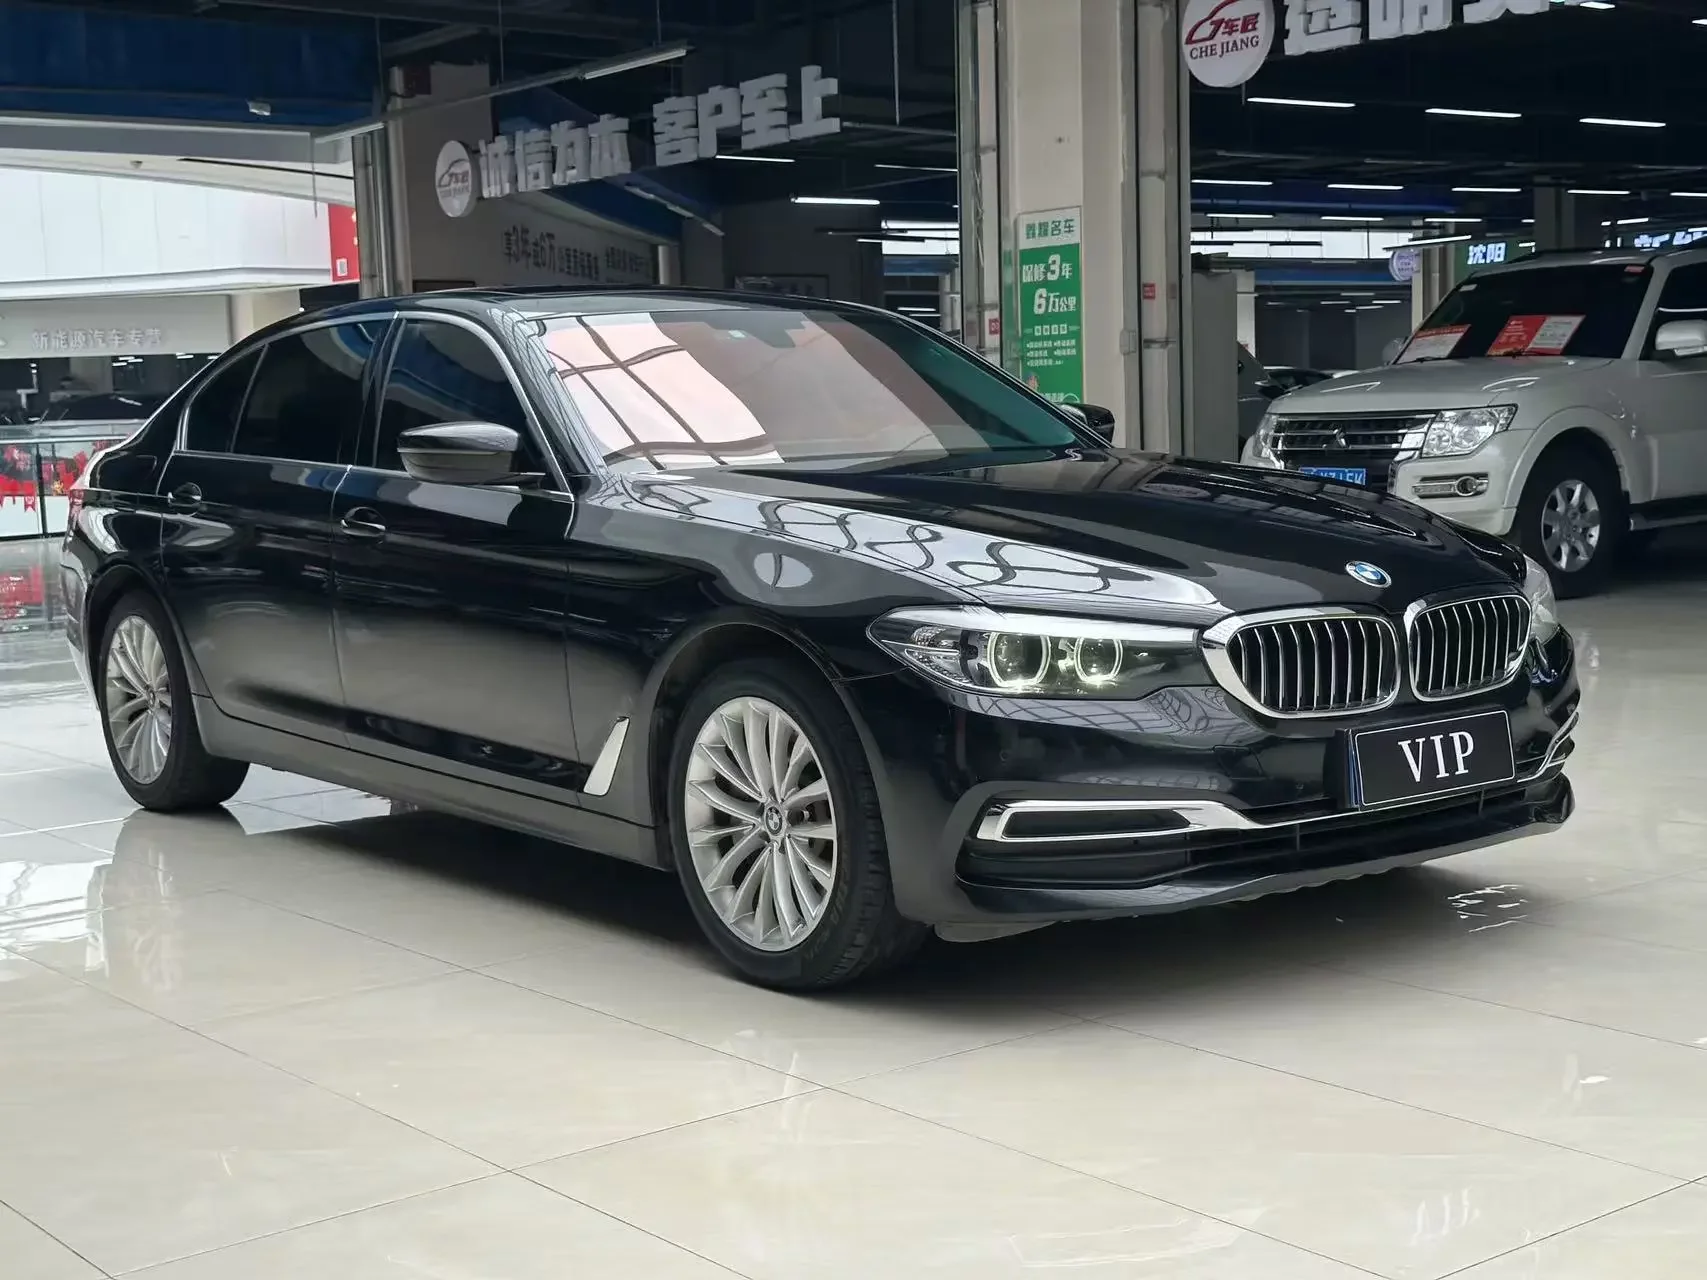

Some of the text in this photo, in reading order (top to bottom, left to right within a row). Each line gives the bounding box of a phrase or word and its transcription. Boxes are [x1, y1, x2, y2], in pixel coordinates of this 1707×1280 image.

[1221, 12, 1260, 36] 车匠
[1189, 35, 1260, 60] CHE JIANG
[652, 65, 841, 167] 客户至上
[1467, 242, 1506, 265] 沈阳
[1022, 253, 1073, 283] 保修3年
[1033, 287, 1077, 315] 6万公里
[1397, 731, 1475, 783] VIP
